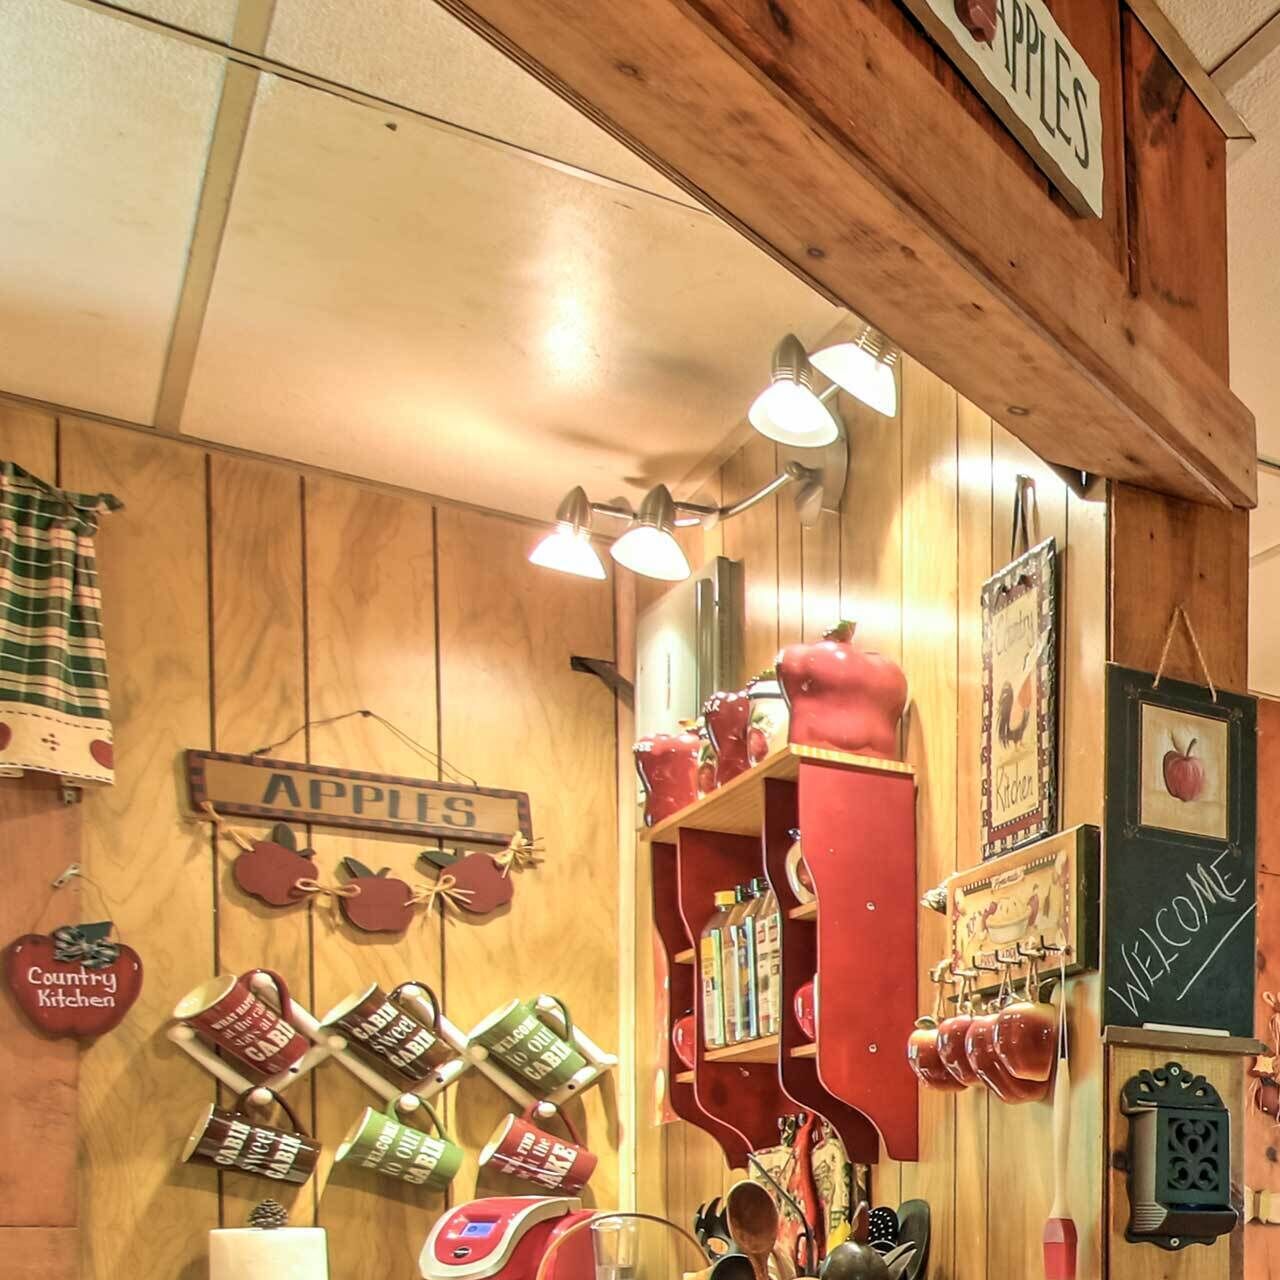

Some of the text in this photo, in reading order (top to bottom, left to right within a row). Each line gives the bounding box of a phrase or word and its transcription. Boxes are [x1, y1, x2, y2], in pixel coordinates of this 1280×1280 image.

[262, 773, 477, 829] APPLES
[995, 764, 1035, 812] Kitchen
[1108, 849, 1247, 1018] WELCOME
[28, 965, 117, 993] Country
[38, 988, 116, 1008] Kitchen
